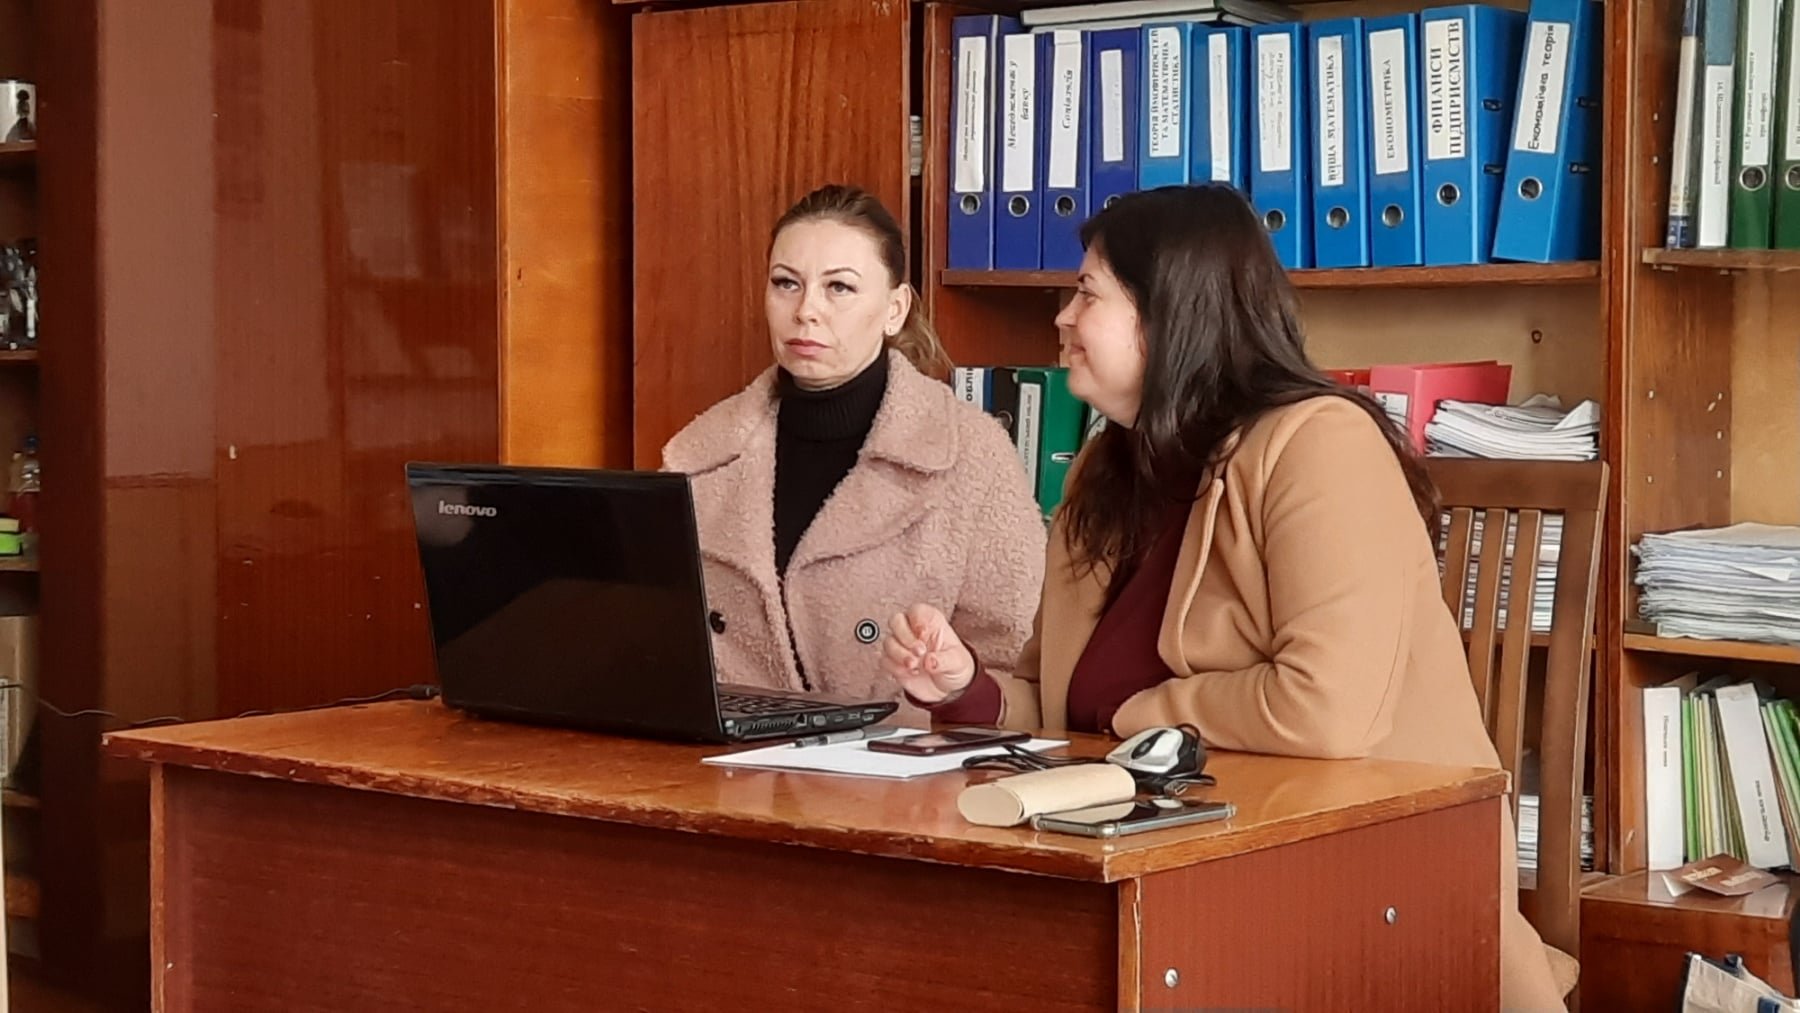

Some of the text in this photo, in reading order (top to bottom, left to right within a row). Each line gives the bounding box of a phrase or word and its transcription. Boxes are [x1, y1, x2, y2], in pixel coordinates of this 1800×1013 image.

[1150, 29, 1159, 153] ТЕОРІЯ ЙМОВІРНОСТЕЙ
[1161, 41, 1169, 139] ТА МАТЕМАТИЧНА
[1171, 54, 1179, 126] СТАТИСТИКА
[1326, 54, 1337, 181] ВИЩА МАТЕМАТИКА
[1382, 58, 1395, 159] ЕКОНОМЕТРИКА
[1430, 47, 1443, 134] ФІНАНСИ
[1448, 21, 1464, 155] ПІДПРИЄМСТВ
[1527, 25, 1555, 151] Економічна теорія
[438, 500, 497, 517] lenovo
